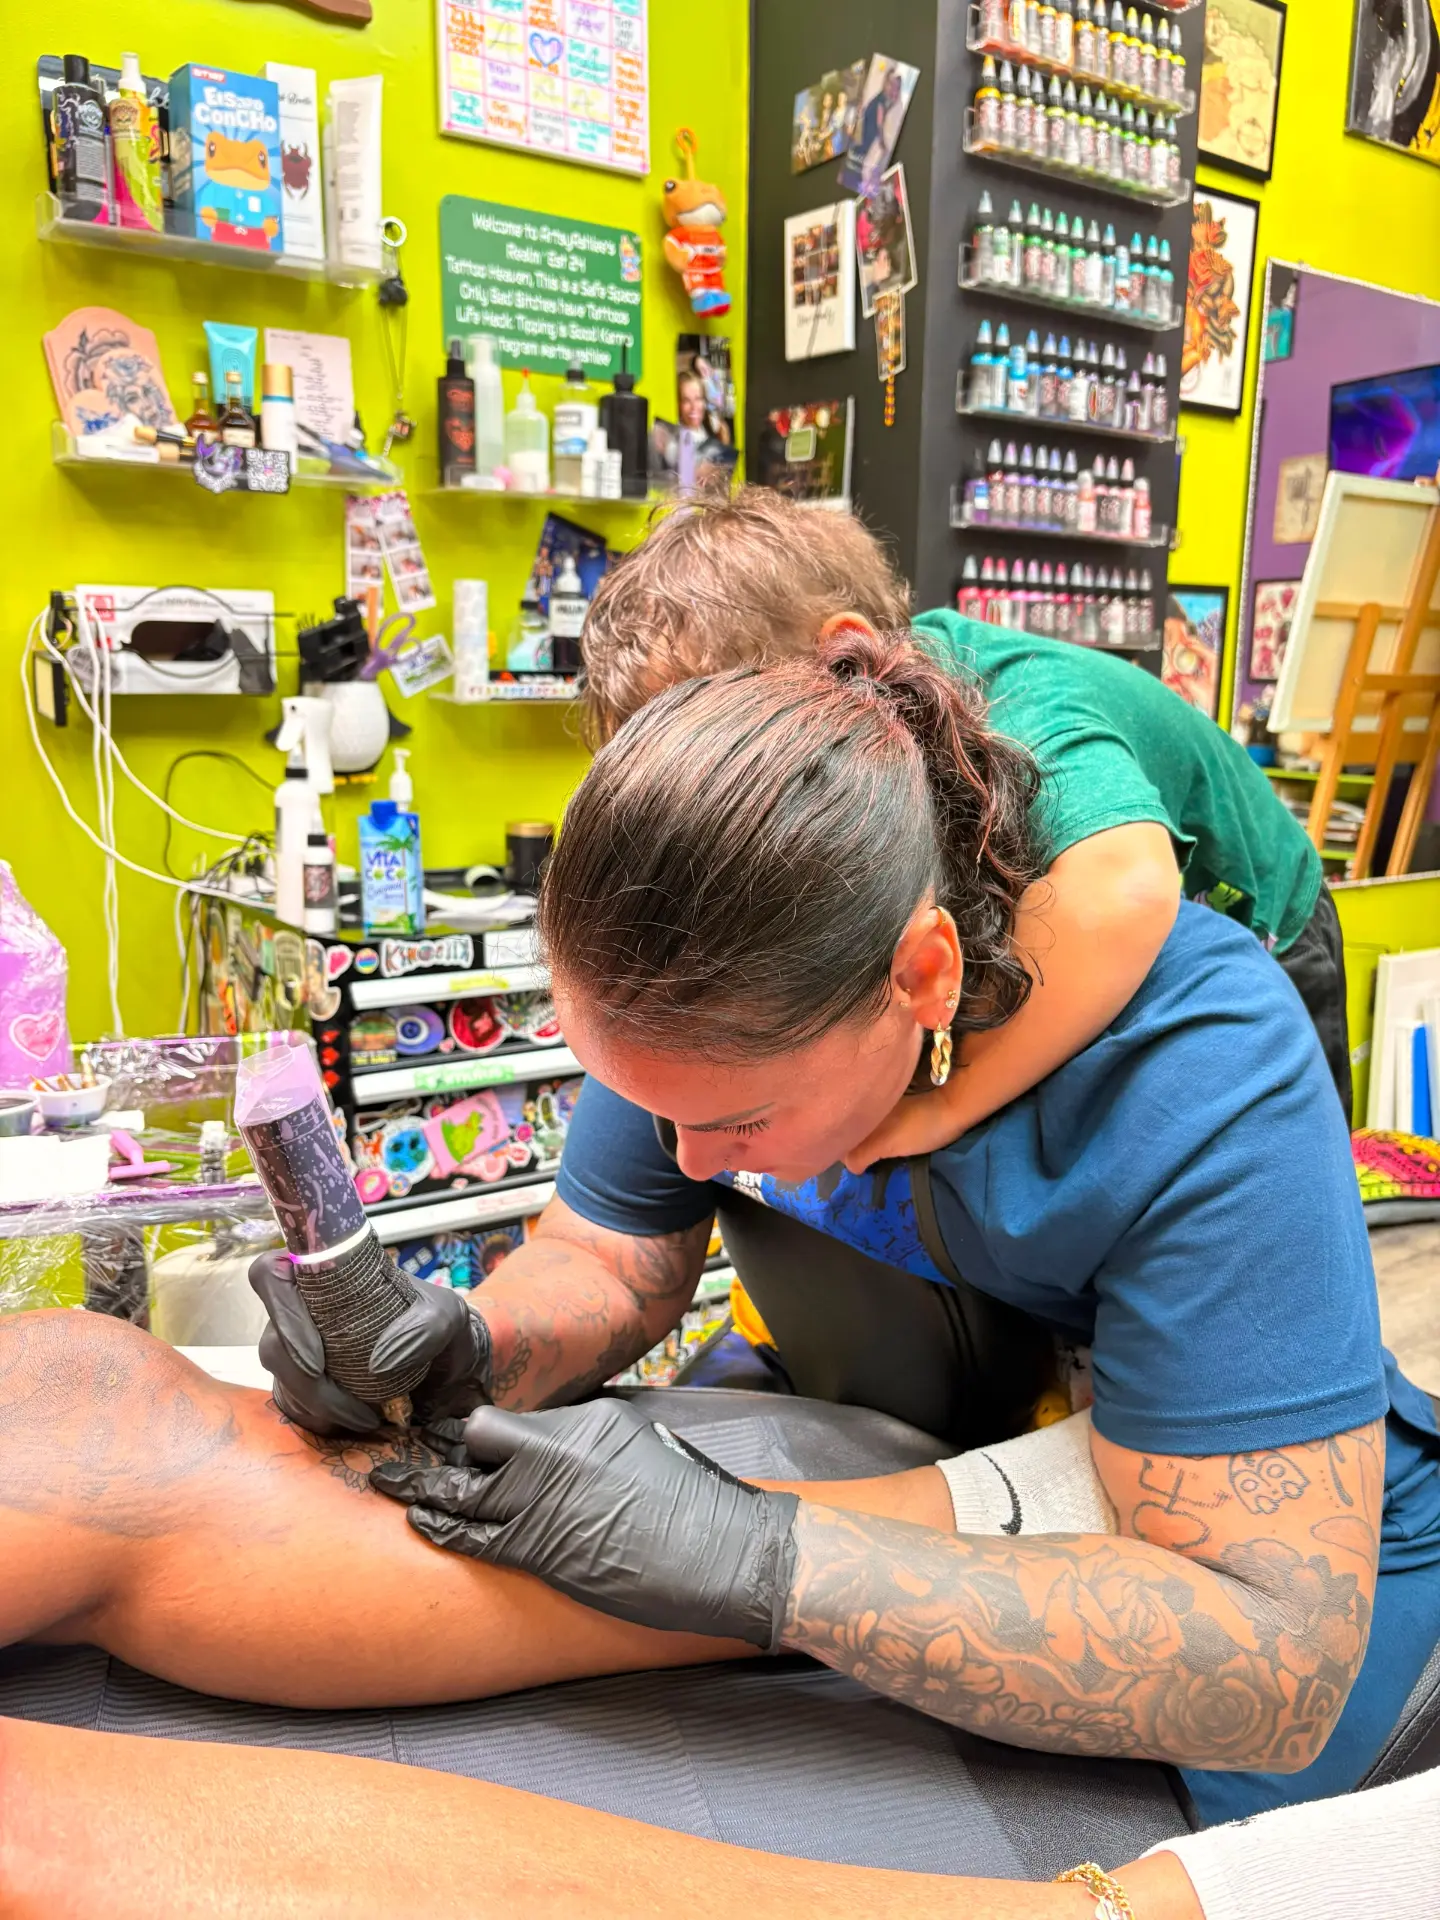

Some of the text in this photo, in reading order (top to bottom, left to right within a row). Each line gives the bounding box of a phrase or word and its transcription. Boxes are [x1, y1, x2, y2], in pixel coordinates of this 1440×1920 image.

[472, 212, 523, 238] Welcome
[524, 223, 539, 241] to
[445, 254, 487, 278] Tattoo
[534, 271, 559, 292] This
[560, 275, 570, 294] is
[571, 280, 580, 296] a
[580, 278, 606, 300] Safe
[606, 282, 640, 305] Space
[459, 281, 488, 307] Only
[514, 289, 557, 314] Bitches
[586, 302, 630, 325] Tattoos
[456, 304, 481, 325] Life
[515, 313, 557, 340] Tipping
[558, 321, 567, 339] is
[568, 321, 600, 343] Good
[366, 851, 401, 867] VITA
